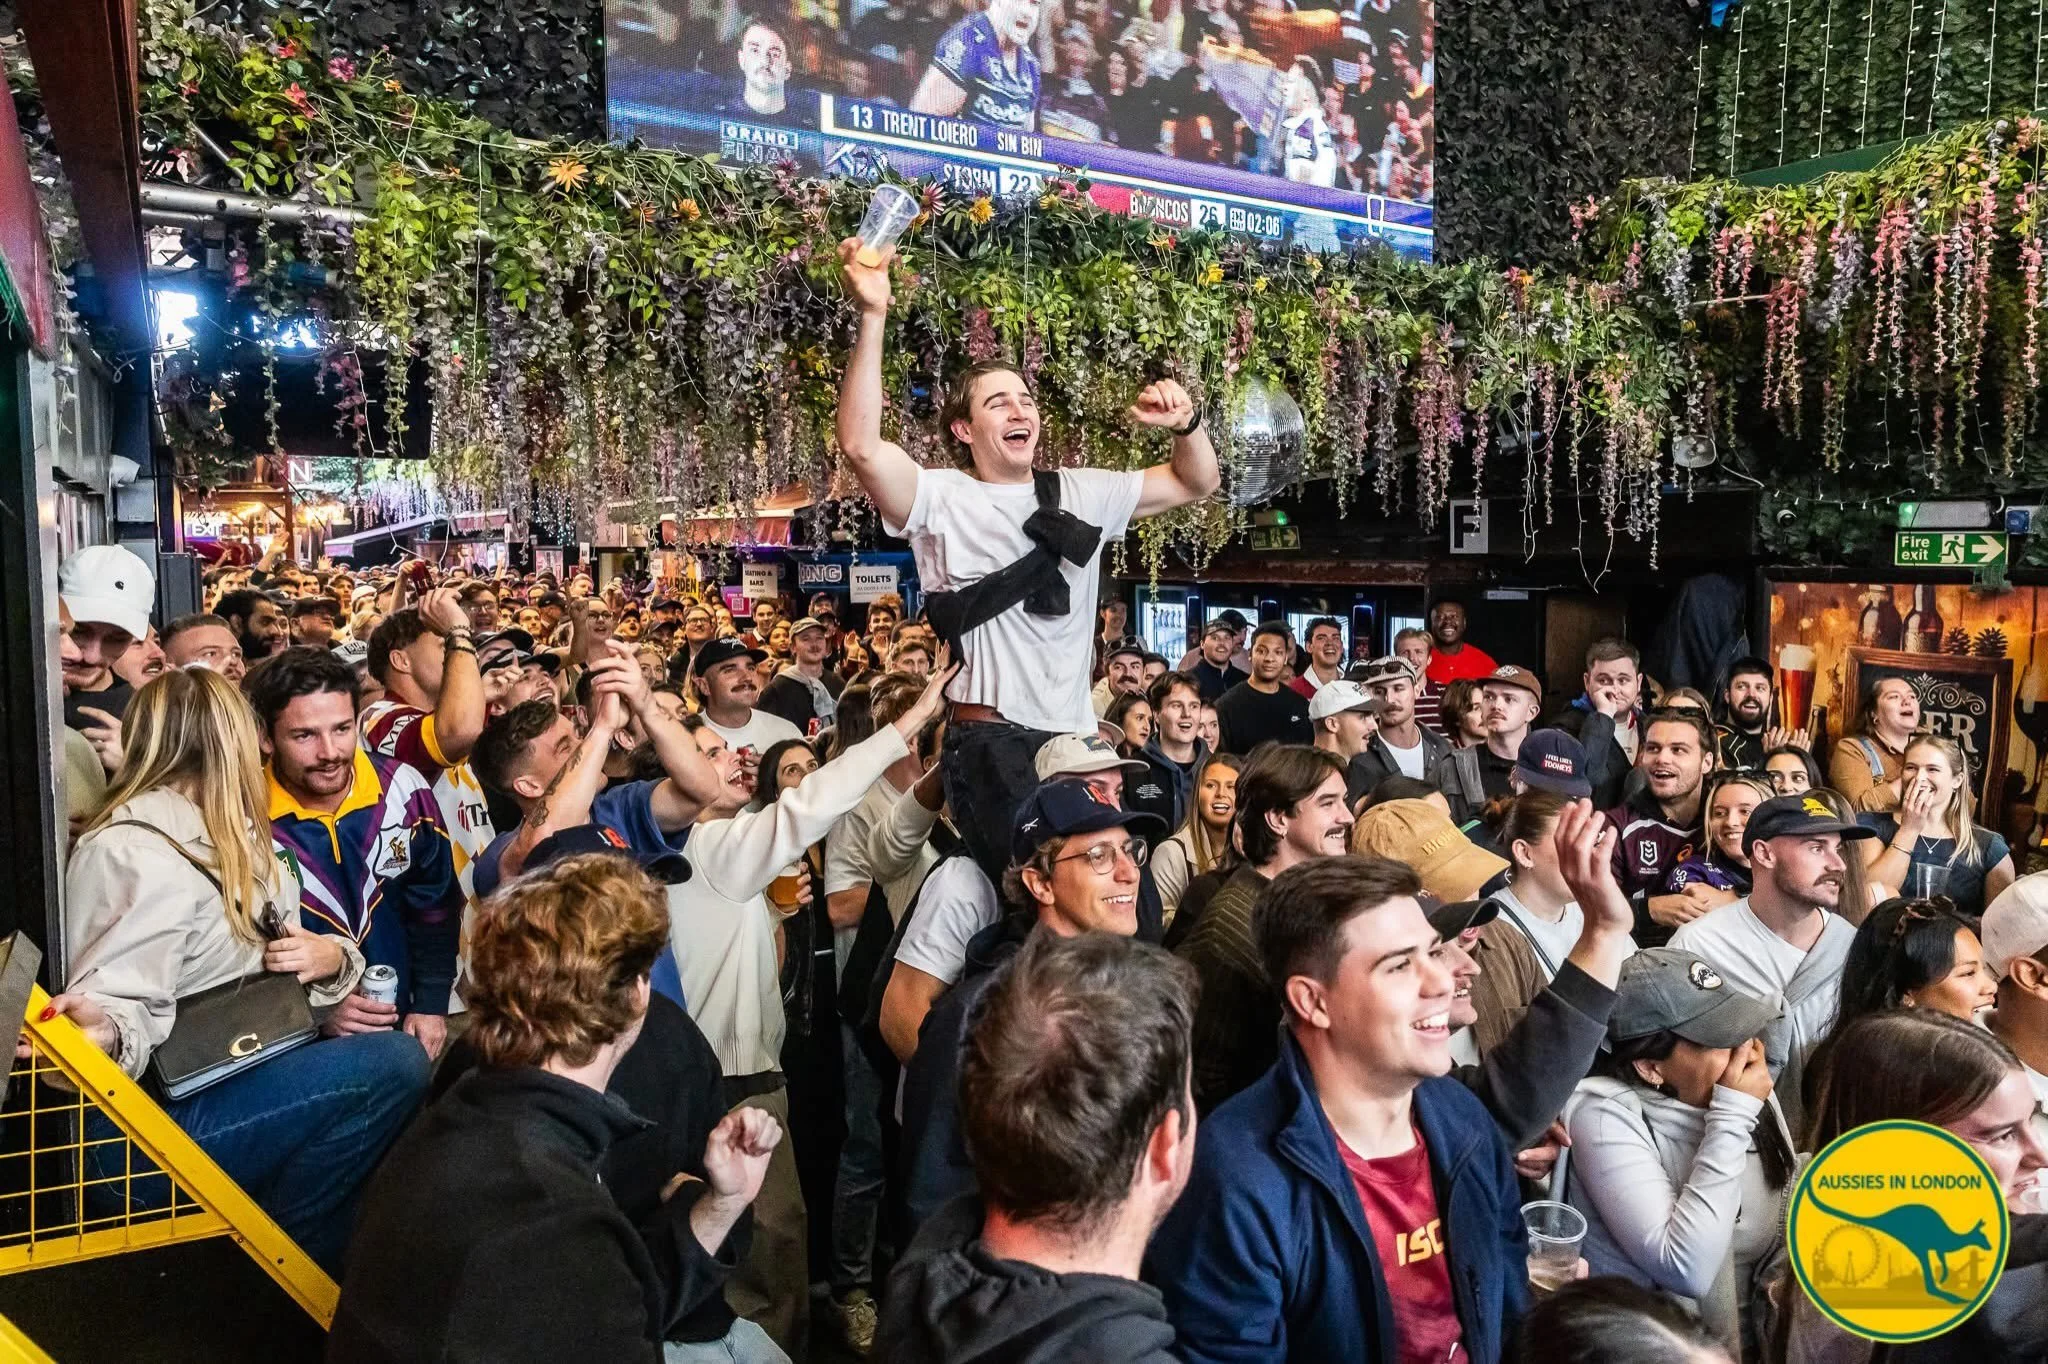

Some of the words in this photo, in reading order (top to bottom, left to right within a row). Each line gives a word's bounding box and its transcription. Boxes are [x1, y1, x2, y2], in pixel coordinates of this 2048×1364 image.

[727, 124, 789, 147] GRAND
[850, 104, 873, 129] 13
[881, 109, 927, 139] TRENT
[930, 118, 978, 148] LOIERO
[997, 132, 1018, 153] SIN
[1021, 137, 1043, 158] BIN
[943, 163, 997, 193] STORM
[1247, 211, 1280, 237] 02:06
[1454, 505, 1482, 548] F
[1901, 535, 1930, 548] Fire
[1901, 548, 1929, 561] exit
[666, 577, 697, 593] ARDEN
[855, 574, 892, 584] TOILETS
[1396, 1218, 1444, 1267] ISC
